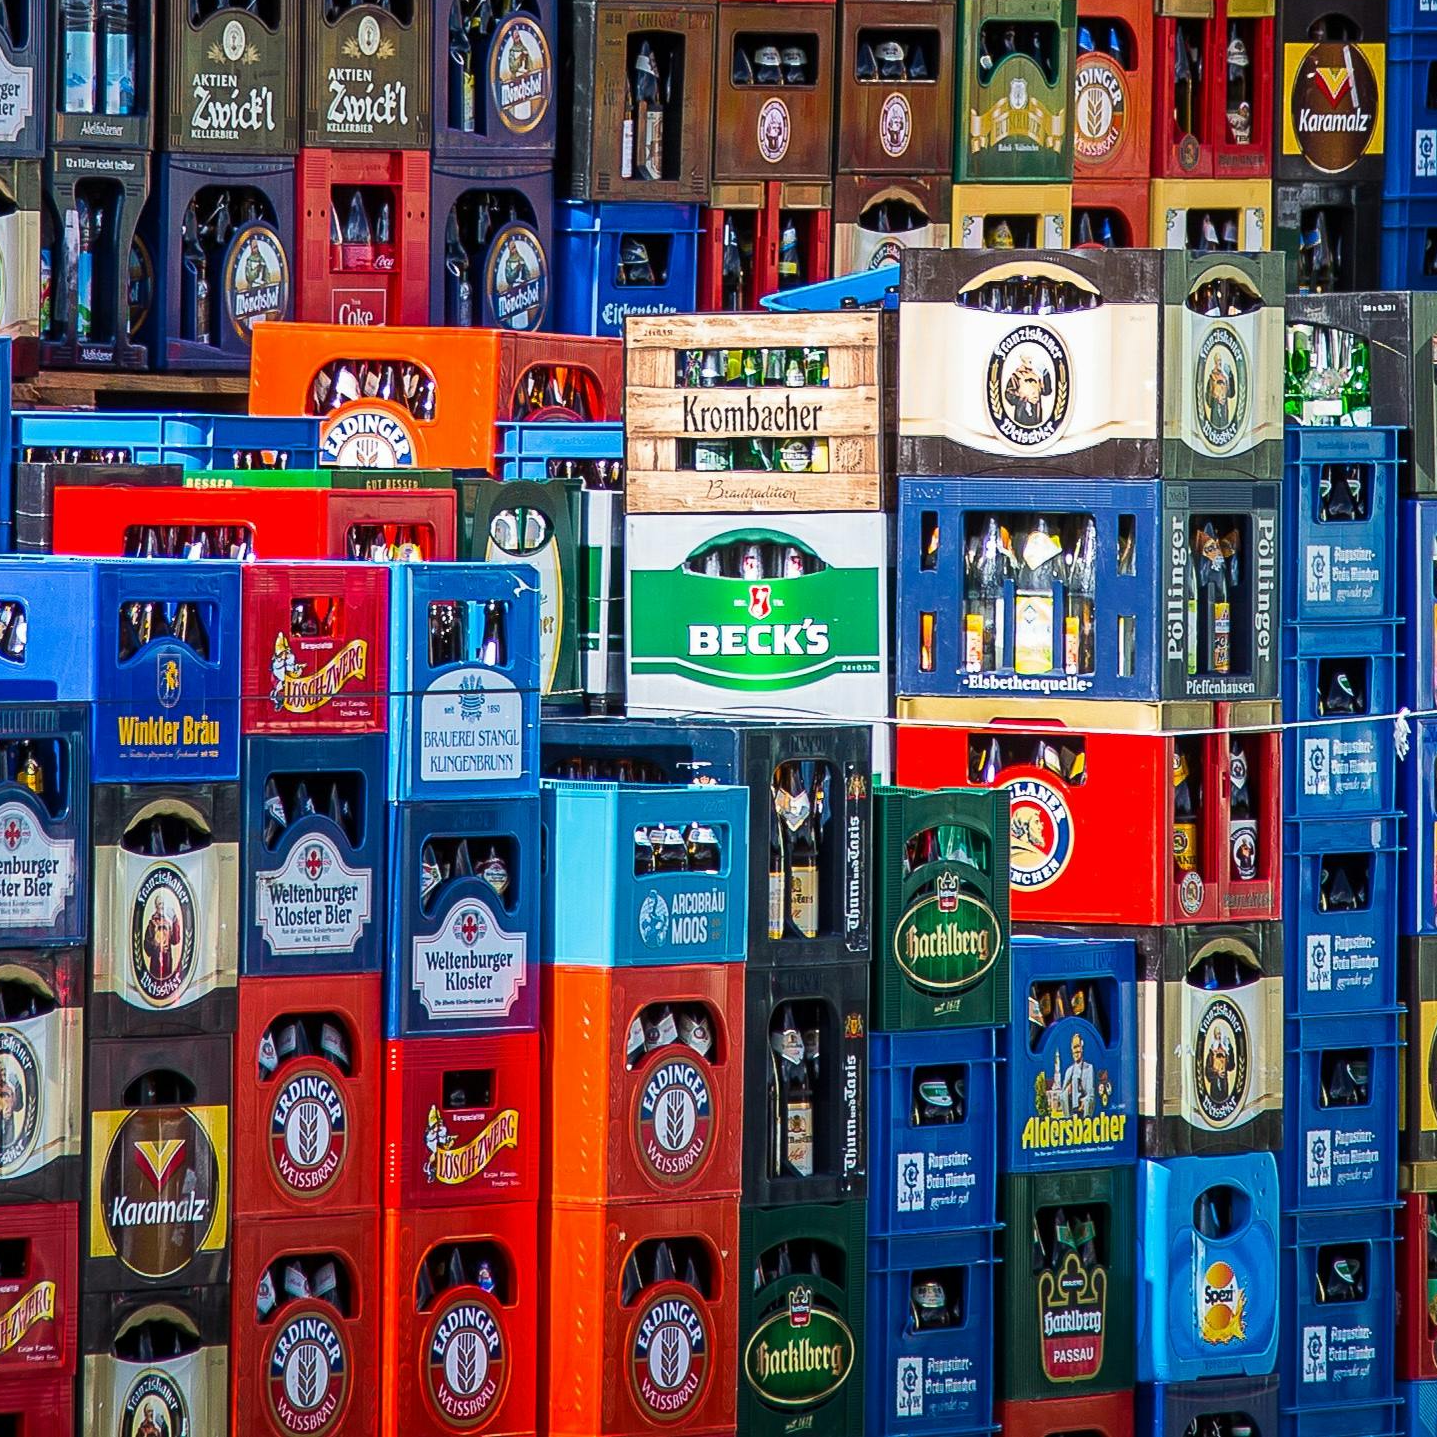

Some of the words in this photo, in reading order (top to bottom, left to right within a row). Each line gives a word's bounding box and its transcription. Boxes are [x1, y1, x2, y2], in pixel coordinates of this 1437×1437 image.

[1299, 107, 1369, 134] Karamalz
[683, 394, 823, 433] Krombacher
[706, 477, 799, 503] Brautradition
[1257, 518, 1272, 662] Pöllinger
[688, 619, 830, 656] BECK'S
[967, 674, 1088, 693] Elsbethenquelle
[118, 717, 180, 745] Winkler
[183, 714, 219, 746] Bräu
[424, 729, 475, 749] BRAUEREI
[477, 730, 519, 748] STANGL
[429, 753, 513, 772] KLINGENBRUNN
[19, 877, 52, 897] Bier
[671, 890, 725, 917] ARCOBRÄU
[671, 916, 706, 945] MOOS
[1022, 1111, 1126, 1150] Aldersbacher
[111, 1194, 207, 1227] Karamalz
[1204, 1284, 1234, 1306] Spezi
[1053, 1347, 1094, 1364] PASSAU
